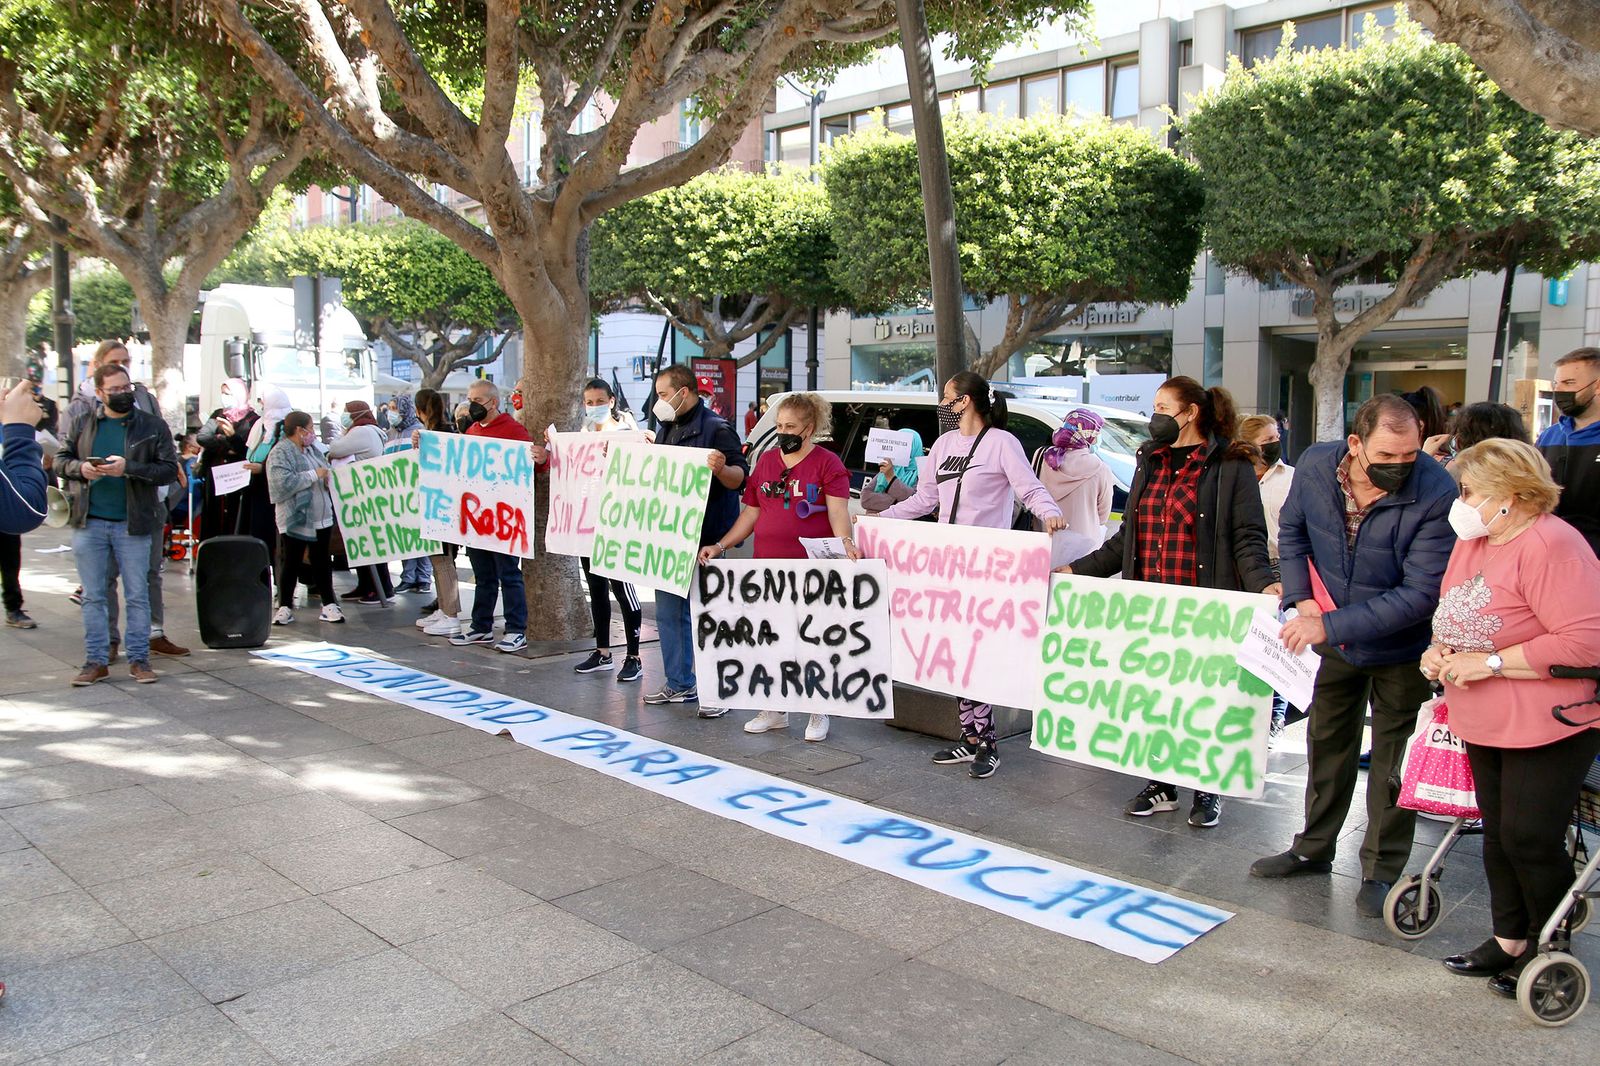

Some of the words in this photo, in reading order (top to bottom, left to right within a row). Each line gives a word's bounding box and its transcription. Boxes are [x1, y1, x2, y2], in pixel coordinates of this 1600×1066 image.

[894, 319, 936, 339] cajam
[1068, 306, 1139, 330] ajamar
[419, 431, 534, 488] ENDESA
[606, 446, 713, 500] ALCALDE
[939, 456, 974, 471] NIKE
[332, 466, 365, 501] LA
[341, 492, 419, 528] COMPLIC
[420, 485, 453, 524] TE
[550, 494, 573, 536] SIN
[345, 536, 371, 560] DE
[592, 533, 622, 571] DE
[699, 564, 881, 610] DIGNIDAD
[698, 611, 780, 651] PARA
[799, 614, 872, 656] LOS
[1251, 625, 1258, 635] LA
[1041, 632, 1109, 667] DEL
[1043, 671, 1255, 743] COMPLICE
[1036, 708, 1077, 751] DE
[1088, 721, 1254, 790] ENDESA
[272, 647, 549, 725] DIGNIDAD
[541, 729, 722, 785] PARA
[721, 785, 832, 827] EL
[839, 817, 1227, 949] PUCHE
